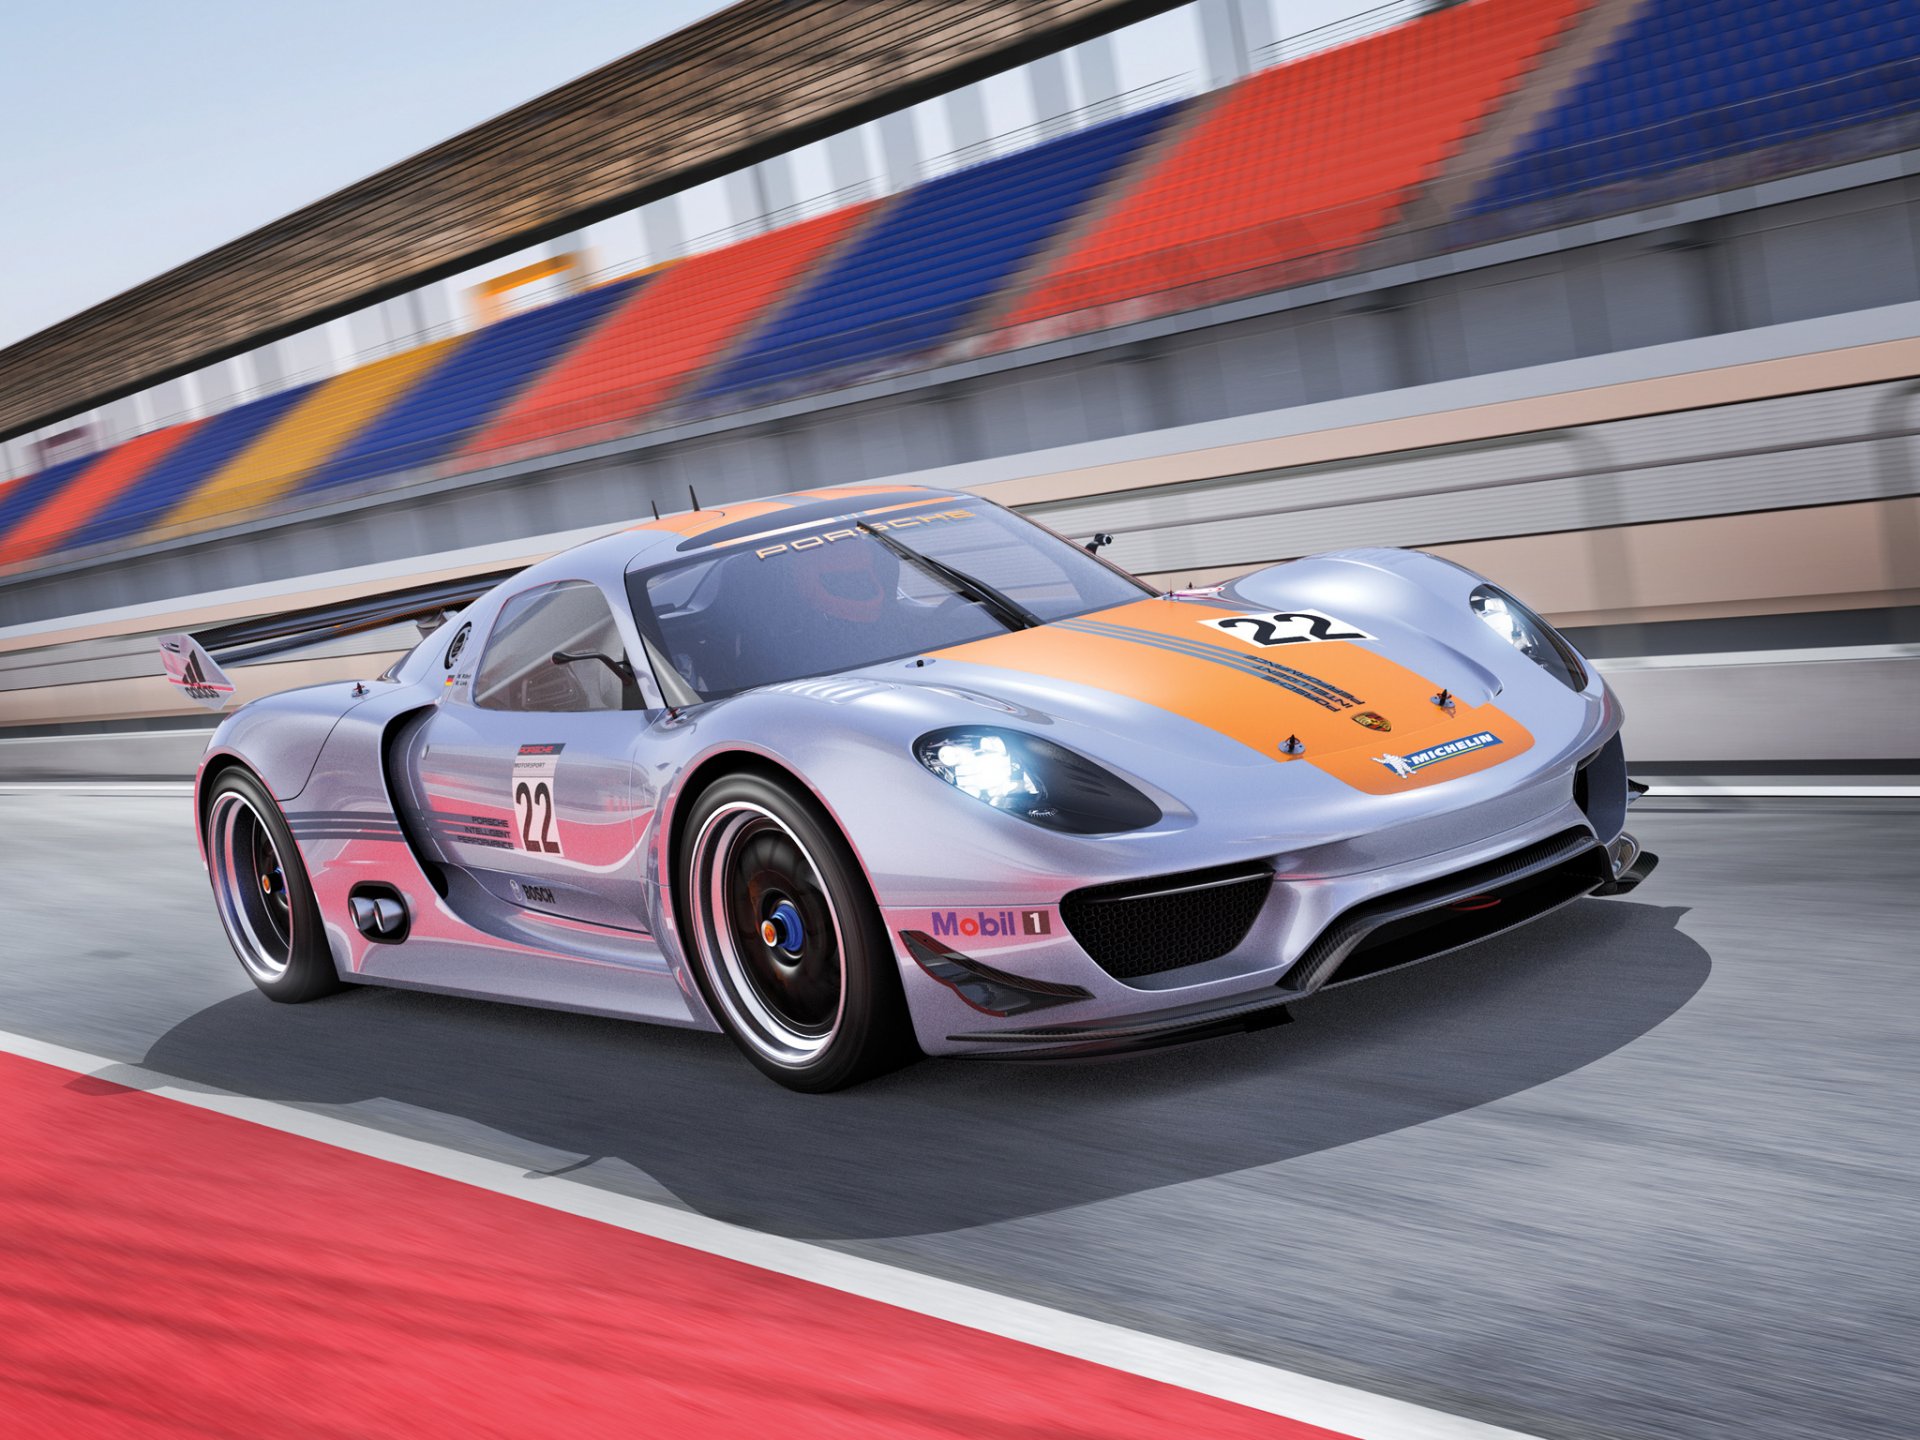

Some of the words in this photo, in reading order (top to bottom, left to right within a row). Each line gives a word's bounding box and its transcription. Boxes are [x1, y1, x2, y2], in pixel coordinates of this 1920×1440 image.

[755, 508, 976, 561] PORSCHE
[1218, 613, 1368, 646] 22
[1262, 675, 1341, 712] PORSCHE
[1412, 733, 1494, 765] MICHELIN
[471, 816, 509, 828] PORSCHE
[515, 782, 560, 853] 22
[457, 835, 514, 850] PERFORMANCE
[464, 826, 511, 839] INTELLIGENT
[521, 884, 556, 904] BOSCH
[931, 911, 1016, 937] Mobil
[1029, 912, 1041, 934] 1
